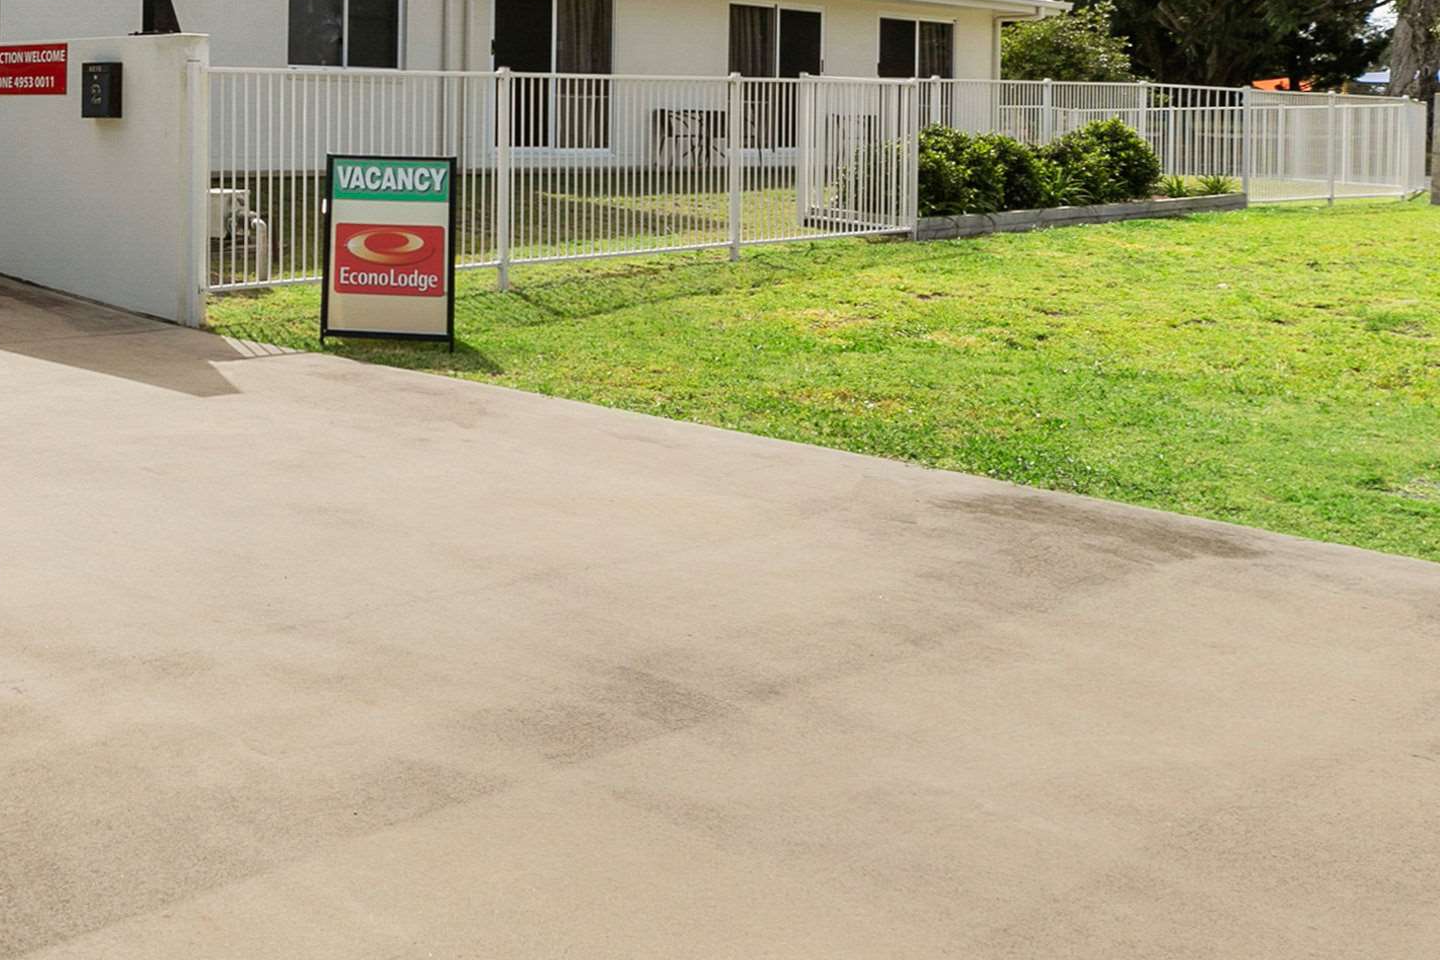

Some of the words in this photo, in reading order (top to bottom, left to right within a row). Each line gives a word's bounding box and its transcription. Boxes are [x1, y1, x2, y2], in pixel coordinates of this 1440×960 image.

[25, 50, 65, 63] WELCOME
[14, 76, 33, 88] 4953
[34, 75, 54, 88] 0011
[336, 166, 446, 192] VACANCY
[339, 266, 438, 290] EconoLodge
